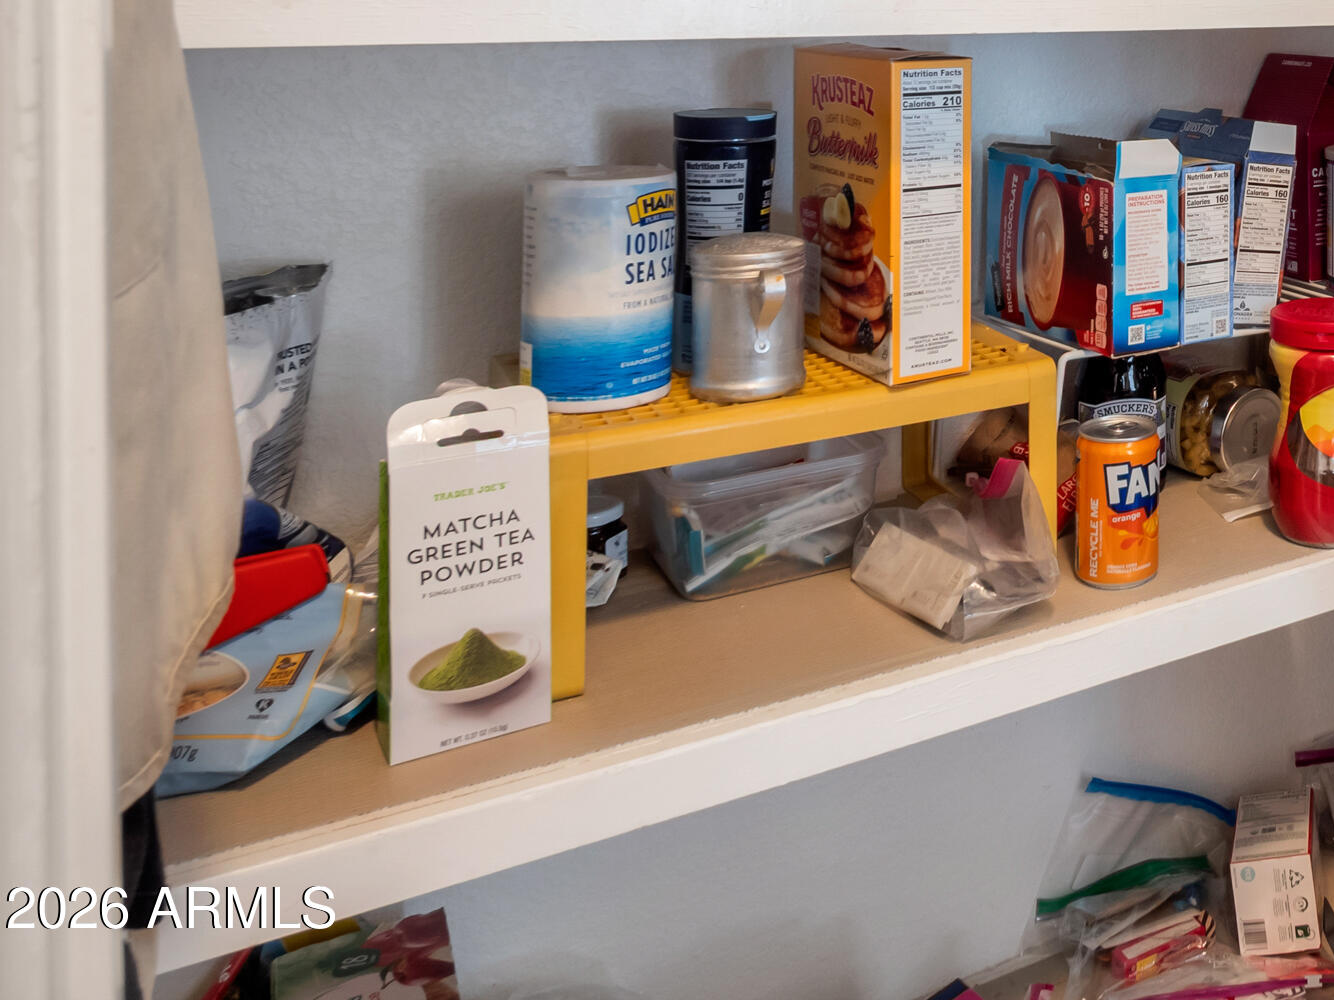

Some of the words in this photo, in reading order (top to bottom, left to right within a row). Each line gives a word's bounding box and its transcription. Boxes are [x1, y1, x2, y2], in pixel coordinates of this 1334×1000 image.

[902, 70, 938, 78] Nutrition
[940, 69, 962, 77] Facts
[811, 73, 875, 118] KRUSTEAZ
[902, 100, 936, 108] Calories
[942, 95, 962, 106] 210
[807, 116, 880, 169] Buttermilk
[687, 162, 720, 170] Nutrition
[723, 162, 745, 170] Facts
[1187, 173, 1213, 181] Nutrition
[1214, 171, 1229, 179] Facts
[1249, 165, 1274, 174] Nutrition
[1275, 167, 1291, 175] Facts
[1128, 194, 1164, 202] PREPARATION
[1187, 198, 1211, 207] Calories
[1215, 194, 1229, 204] 160
[1246, 189, 1270, 197] Calories
[1274, 189, 1288, 198] 160
[643, 194, 675, 214] HAIN
[1006, 173, 1018, 249] CHOCOLATE
[1128, 200, 1165, 208] INSTRUCTIONS
[625, 225, 675, 256] IODIZE
[625, 259, 656, 285] SEA
[661, 255, 675, 279] SA
[1096, 403, 1156, 419] SMUCKER'S
[433, 487, 474, 502] TRADER
[476, 481, 508, 494] JOE'S
[1106, 462, 1160, 506] FAN
[1090, 498, 1099, 519] ME
[1112, 512, 1142, 524] orange
[422, 508, 521, 540] MATCHA
[406, 536, 484, 566] GREEN
[493, 527, 536, 551] TEA
[1089, 520, 1099, 578] RECYCLE
[419, 551, 524, 587] POWDER
[428, 581, 485, 599] SINGLE-SERVE
[486, 573, 522, 586] PACKETS
[172, 745, 200, 762] 07g
